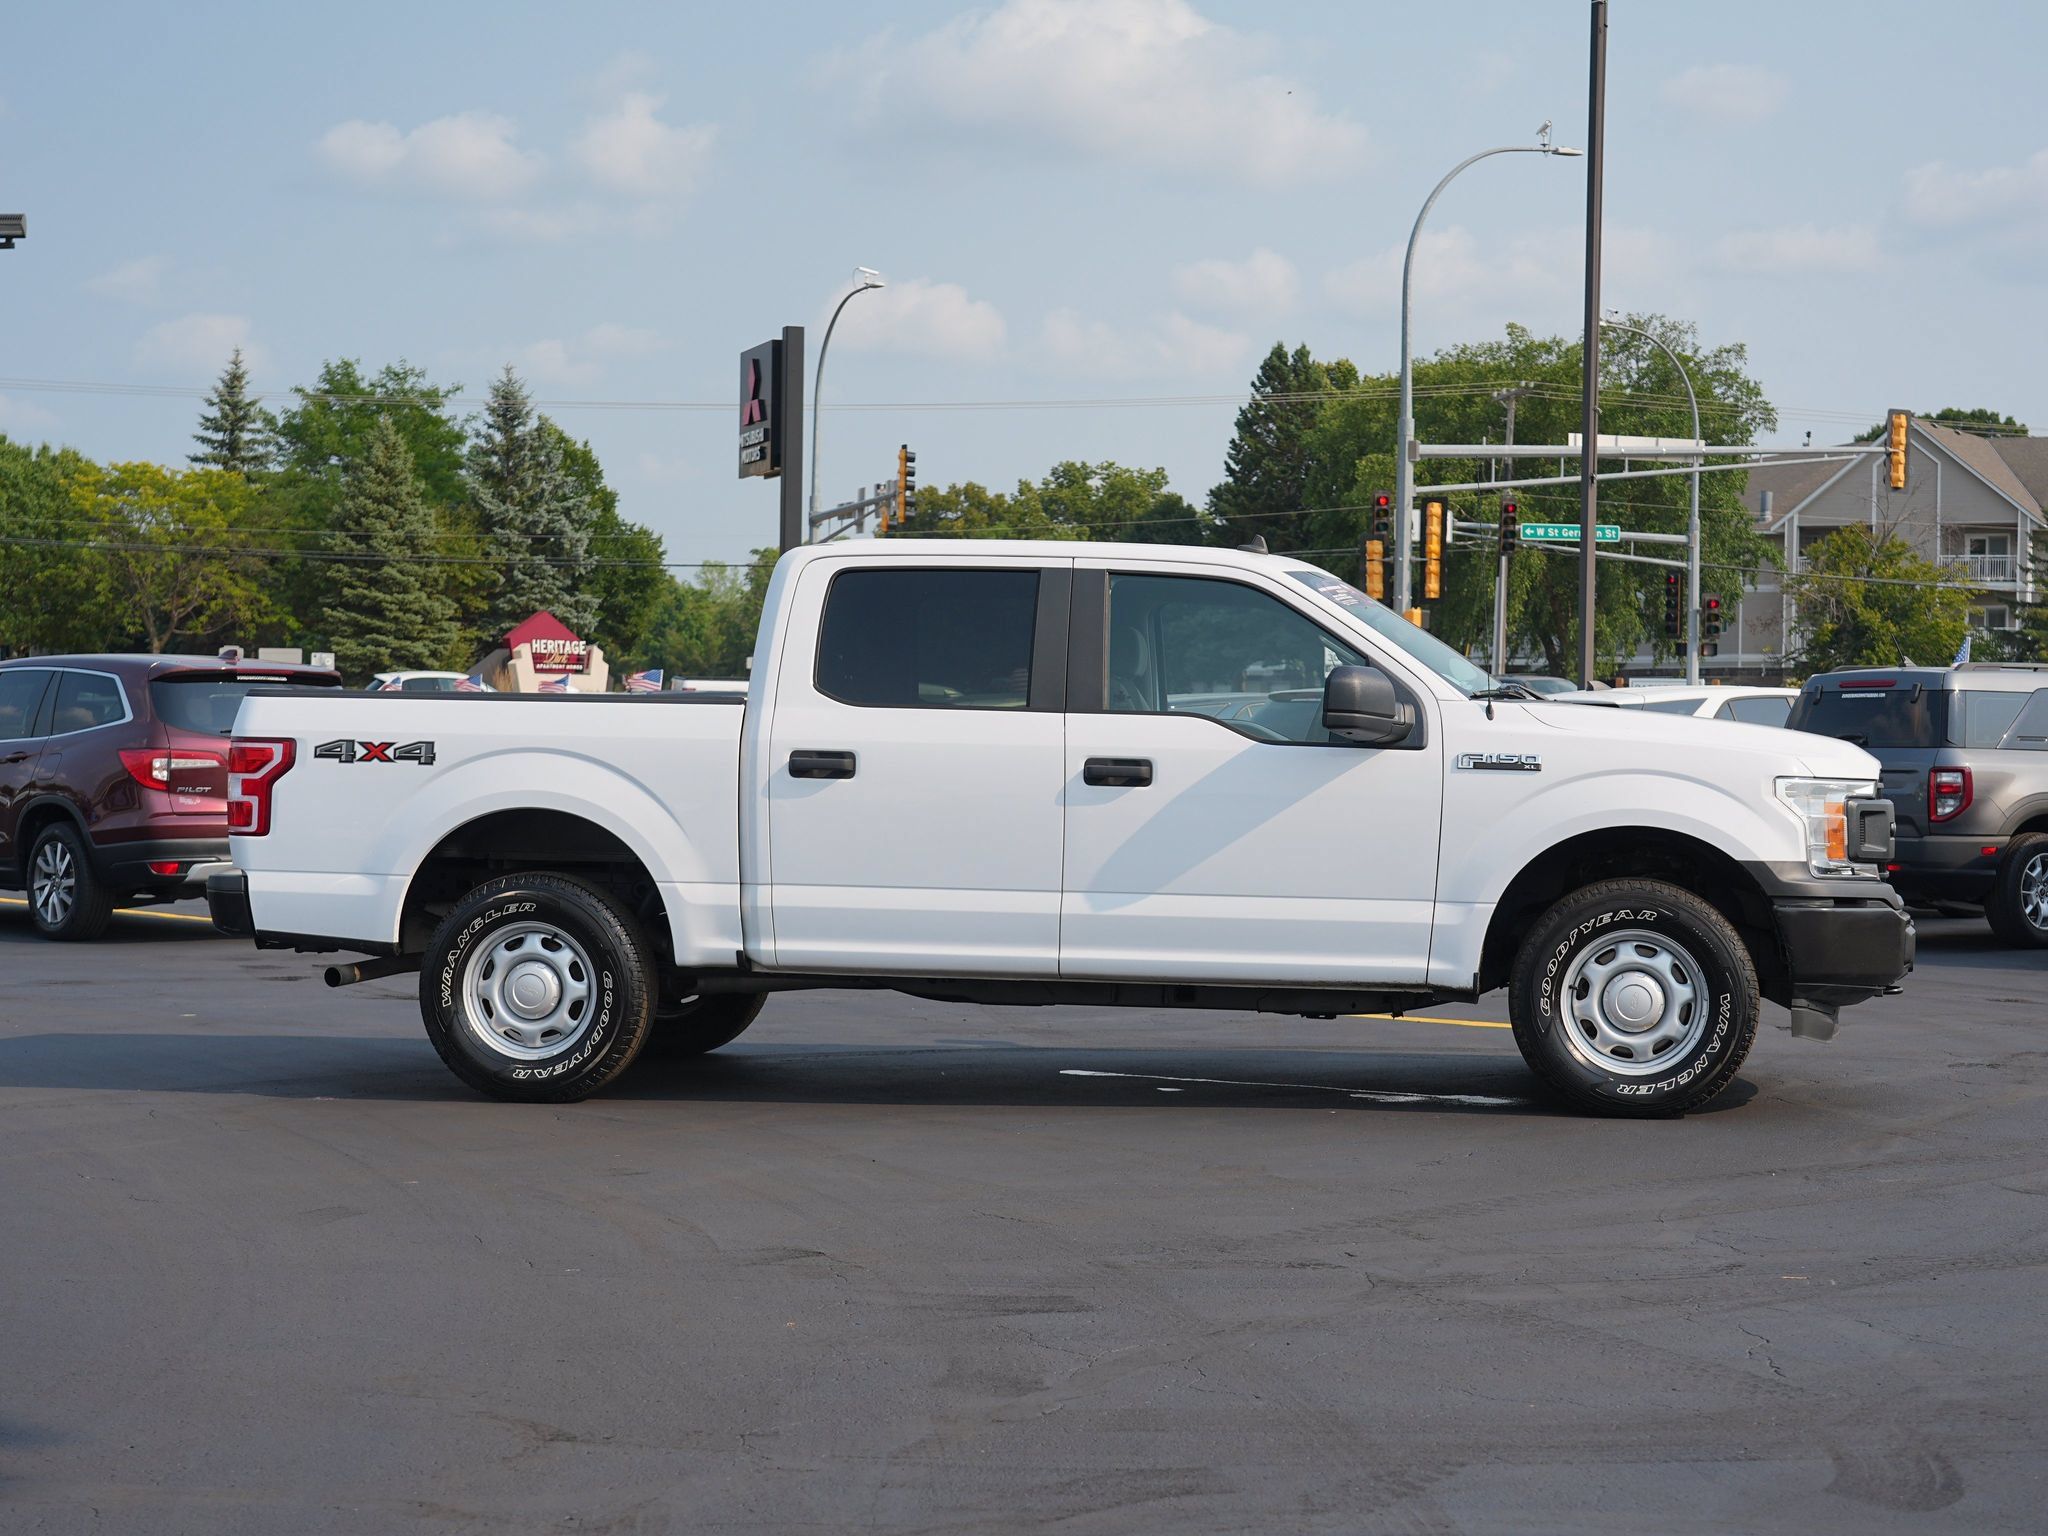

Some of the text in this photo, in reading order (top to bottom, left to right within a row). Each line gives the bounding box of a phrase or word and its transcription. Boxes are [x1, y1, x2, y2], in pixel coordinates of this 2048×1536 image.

[1536, 527, 1545, 536] W
[1547, 527, 1559, 537] St
[1605, 529, 1616, 538] St
[531, 639, 586, 655] HERITAGE
[442, 902, 537, 1008] WRANGLER
[1540, 909, 1658, 1017] GOODYEAR
[512, 971, 613, 1079] GOODYEAR
[1616, 993, 1731, 1095] WRANGLER
